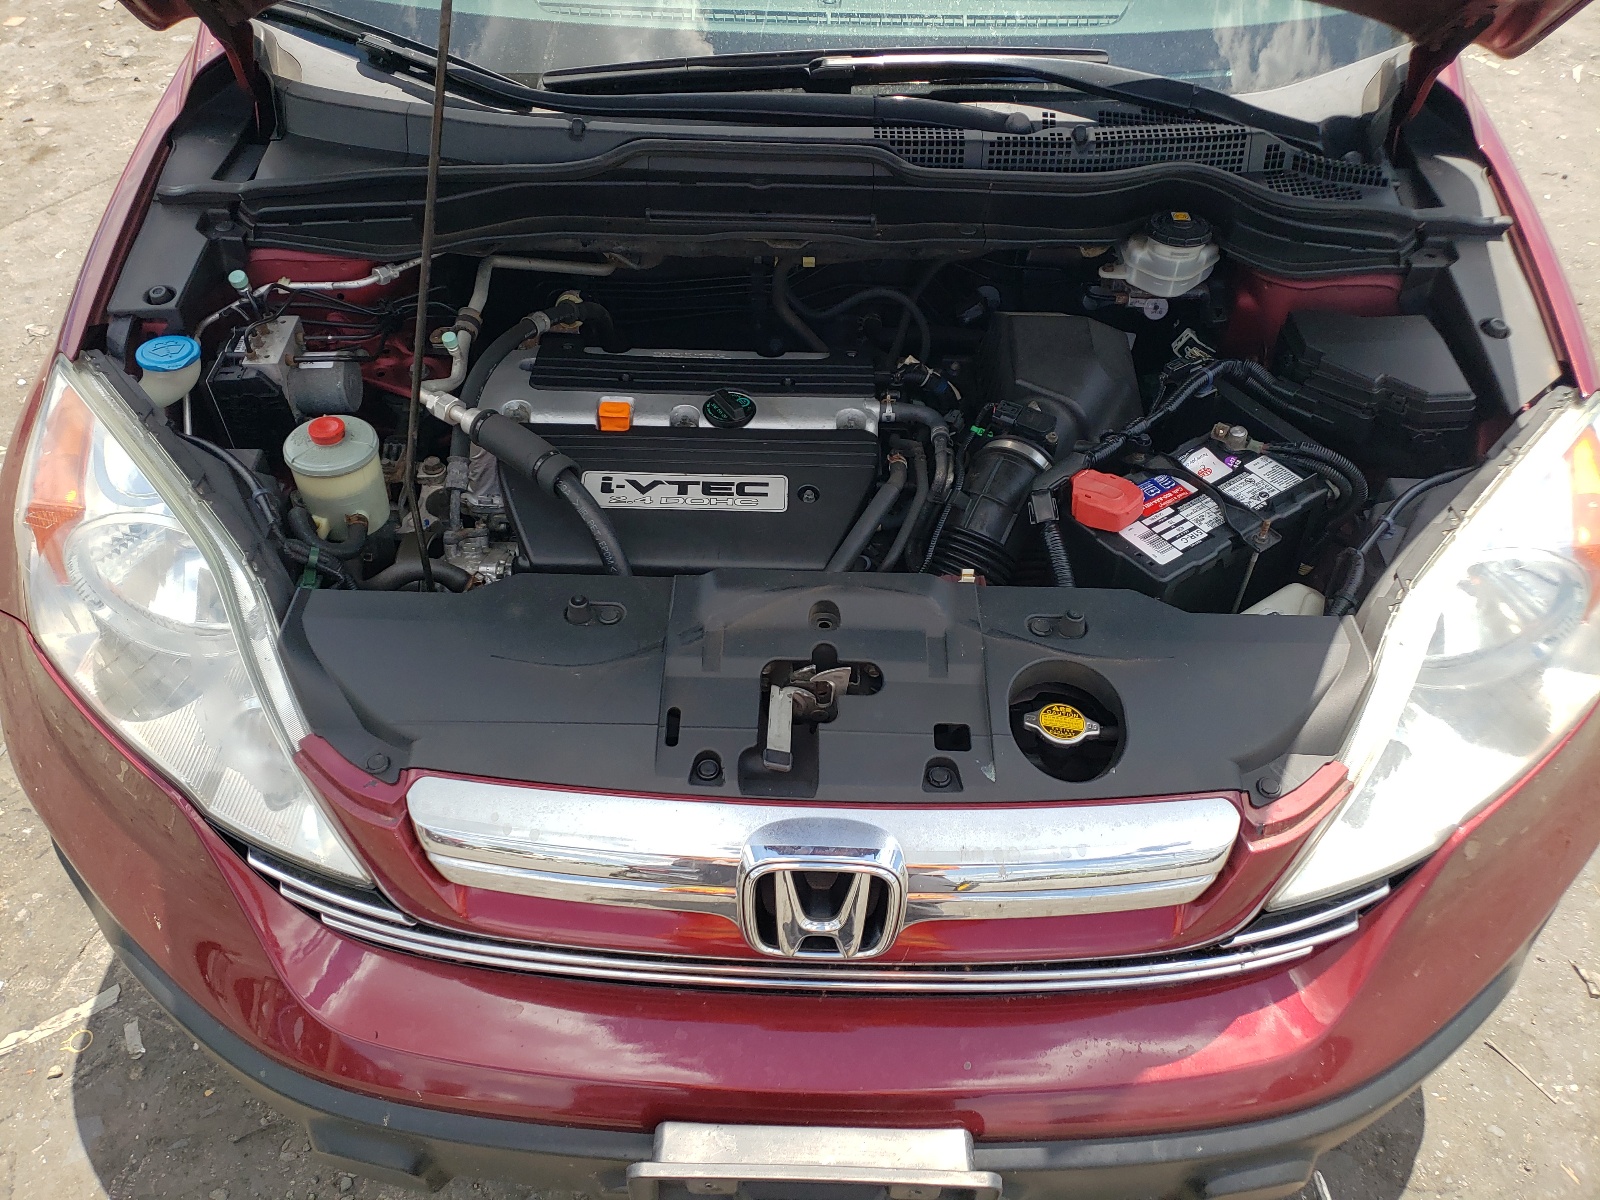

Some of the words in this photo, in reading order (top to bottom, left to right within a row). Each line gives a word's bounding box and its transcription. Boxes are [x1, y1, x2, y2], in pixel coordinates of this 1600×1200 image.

[601, 476, 769, 497] i-VTEC
[609, 496, 653, 505] 2.4
[659, 497, 759, 507] DOHC
[1181, 528, 1204, 544] 51R-C
[1046, 710, 1079, 718] CAUTION
